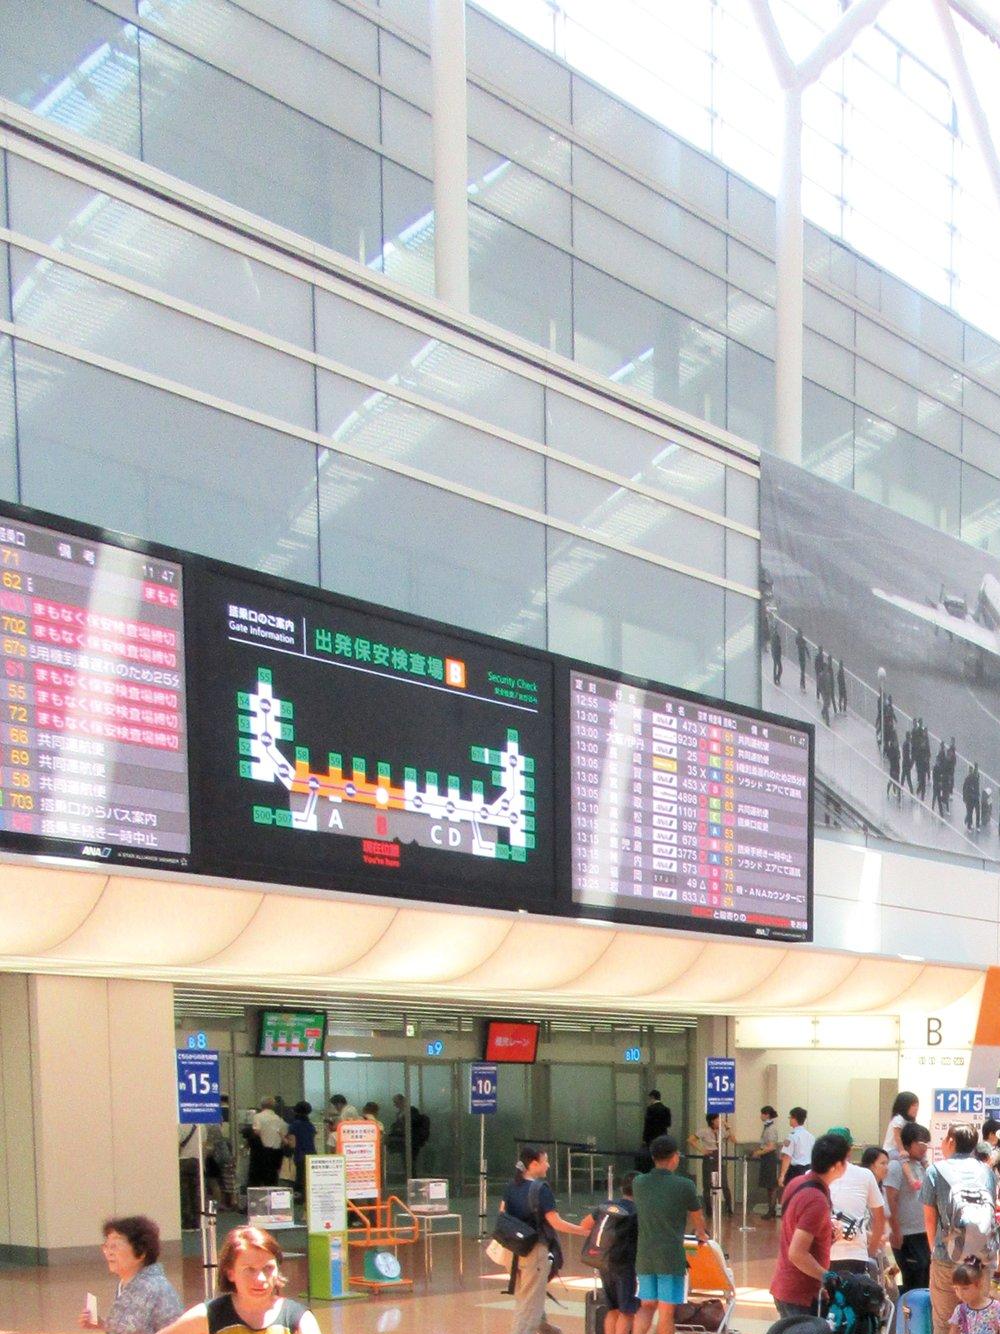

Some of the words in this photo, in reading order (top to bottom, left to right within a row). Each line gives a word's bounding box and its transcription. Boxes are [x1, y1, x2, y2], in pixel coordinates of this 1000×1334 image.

[2, 571, 22, 590] 62
[2, 615, 27, 635] 702
[228, 620, 248, 634] Gate
[249, 625, 295, 645] Information
[315, 628, 444, 681] 出発保安検査場
[450, 662, 461, 684] B
[487, 671, 516, 688] Security
[516, 678, 538, 692] Check
[8, 705, 28, 723] 72
[687, 750, 698, 762] 25
[687, 765, 698, 777] 35
[328, 808, 344, 830] A
[430, 825, 442, 845] C
[448, 827, 461, 847] D
[82, 845, 102, 858] ANA
[926, 1017, 943, 1046] B
[188, 1032, 207, 1050] B8
[427, 1040, 443, 1056] B9
[625, 1048, 640, 1061] B10
[188, 1073, 211, 1095] 15
[477, 1079, 492, 1095] 10
[714, 1075, 730, 1092] 15
[936, 1093, 958, 1111] 12
[963, 1093, 983, 1111] 15
